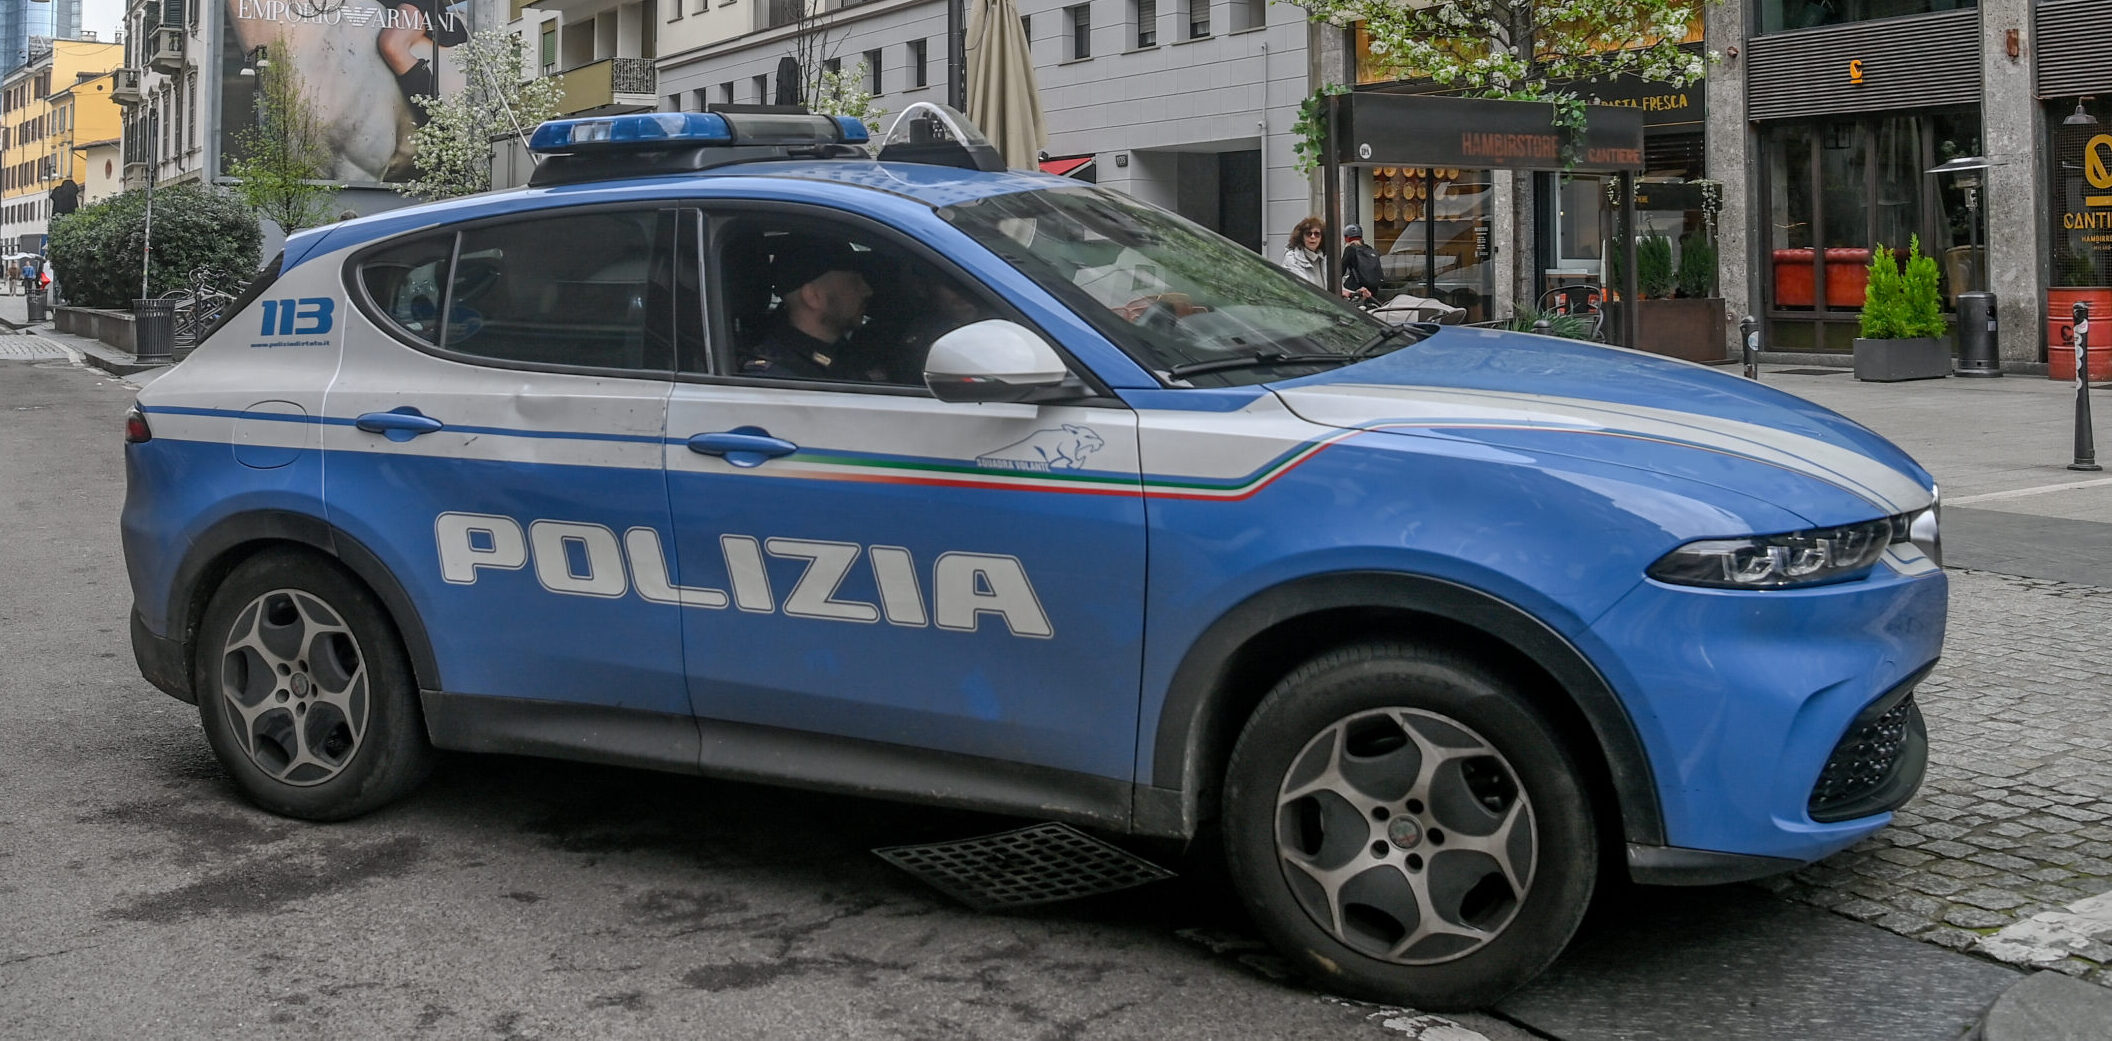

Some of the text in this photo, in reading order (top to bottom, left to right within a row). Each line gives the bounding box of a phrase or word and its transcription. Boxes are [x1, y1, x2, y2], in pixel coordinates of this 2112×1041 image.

[238, 0, 455, 33] EMPORIO ARMANI
[1642, 94, 1689, 112] FRESCA
[1462, 132, 1559, 158] HAMBIRSTORE
[1588, 148, 1642, 164] CANTIERE
[261, 297, 335, 337] 113
[976, 457, 1052, 473] SQUADRA VOLANTE
[434, 510, 1055, 640] POLIZIA
